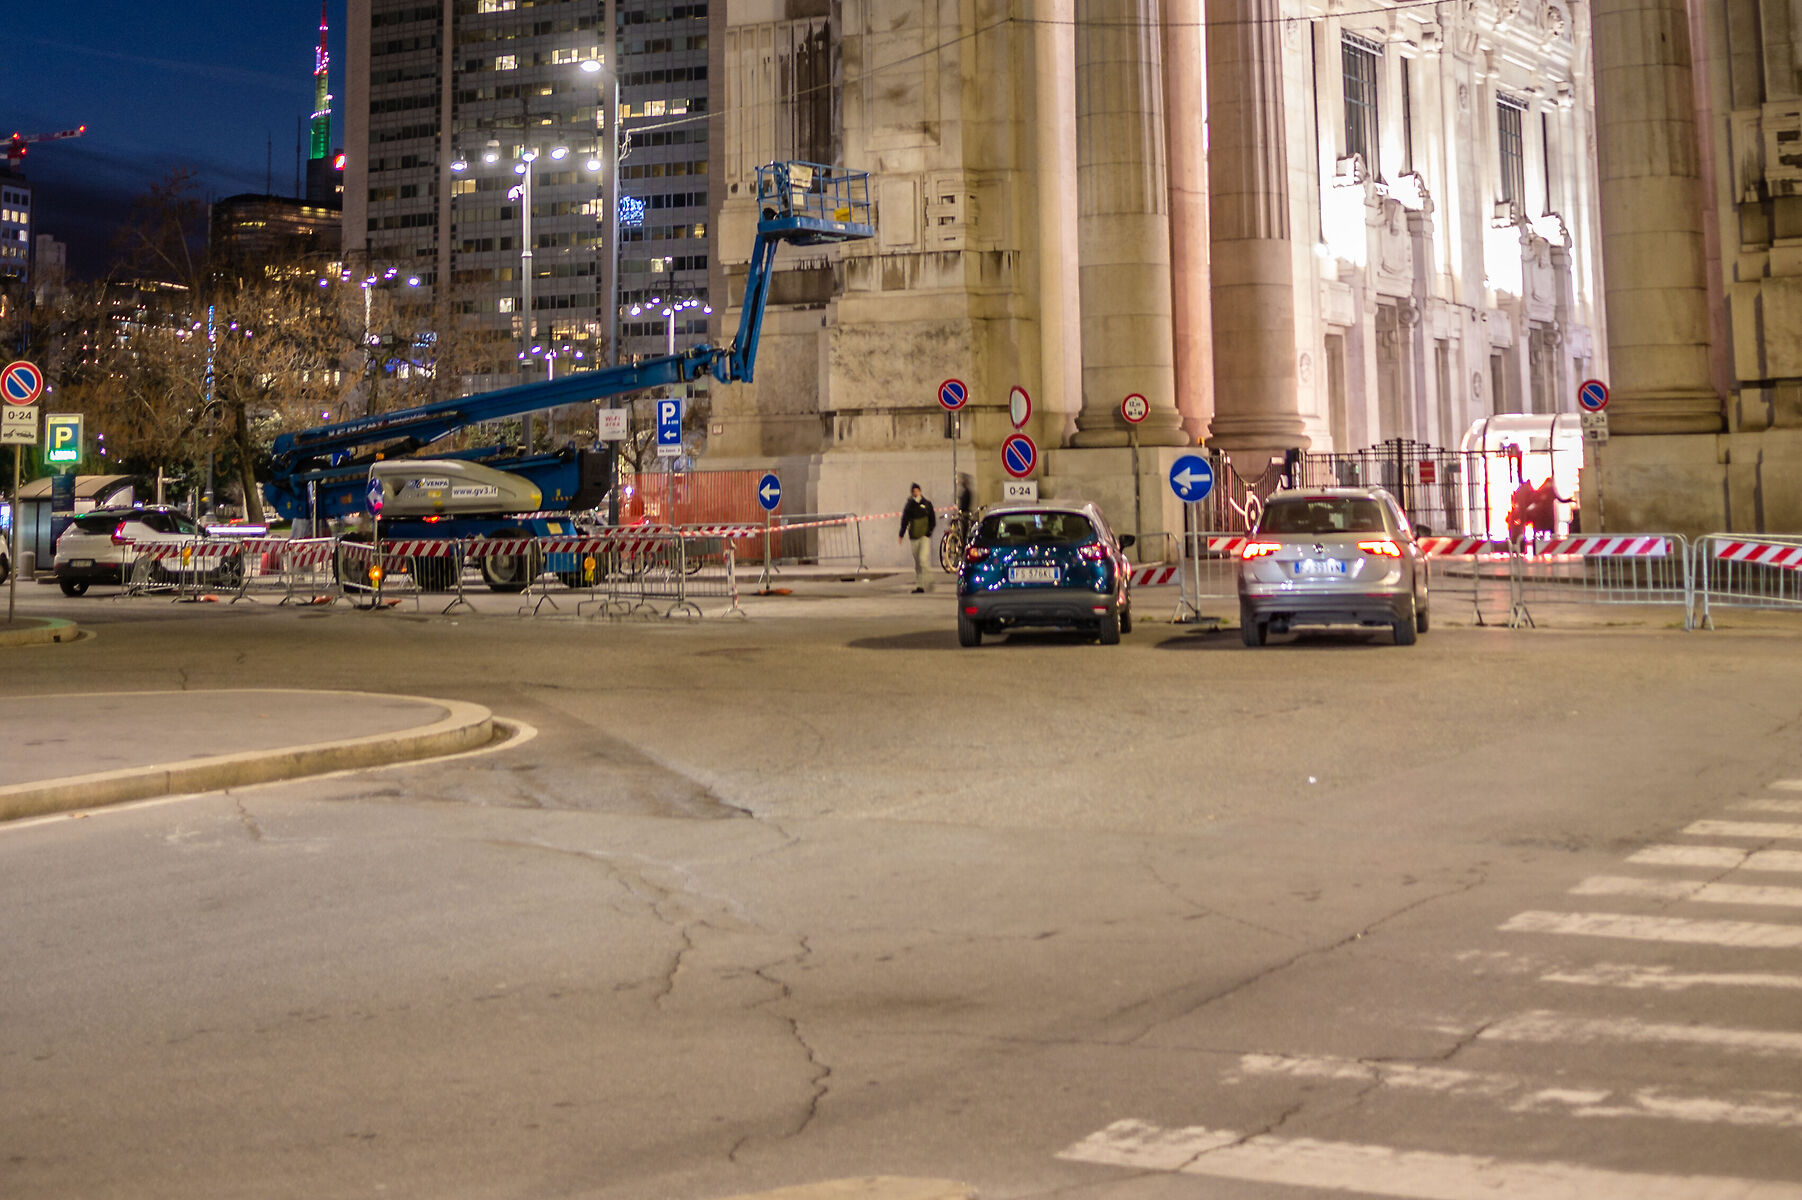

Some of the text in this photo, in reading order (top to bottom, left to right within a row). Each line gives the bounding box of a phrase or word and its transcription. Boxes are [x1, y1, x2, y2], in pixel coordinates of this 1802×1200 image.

[8, 411, 32, 420] 0-24
[662, 402, 676, 425] P
[55, 426, 73, 449] P
[453, 486, 497, 496] www.gv3.it
[1009, 486, 1031, 496] 0-24
